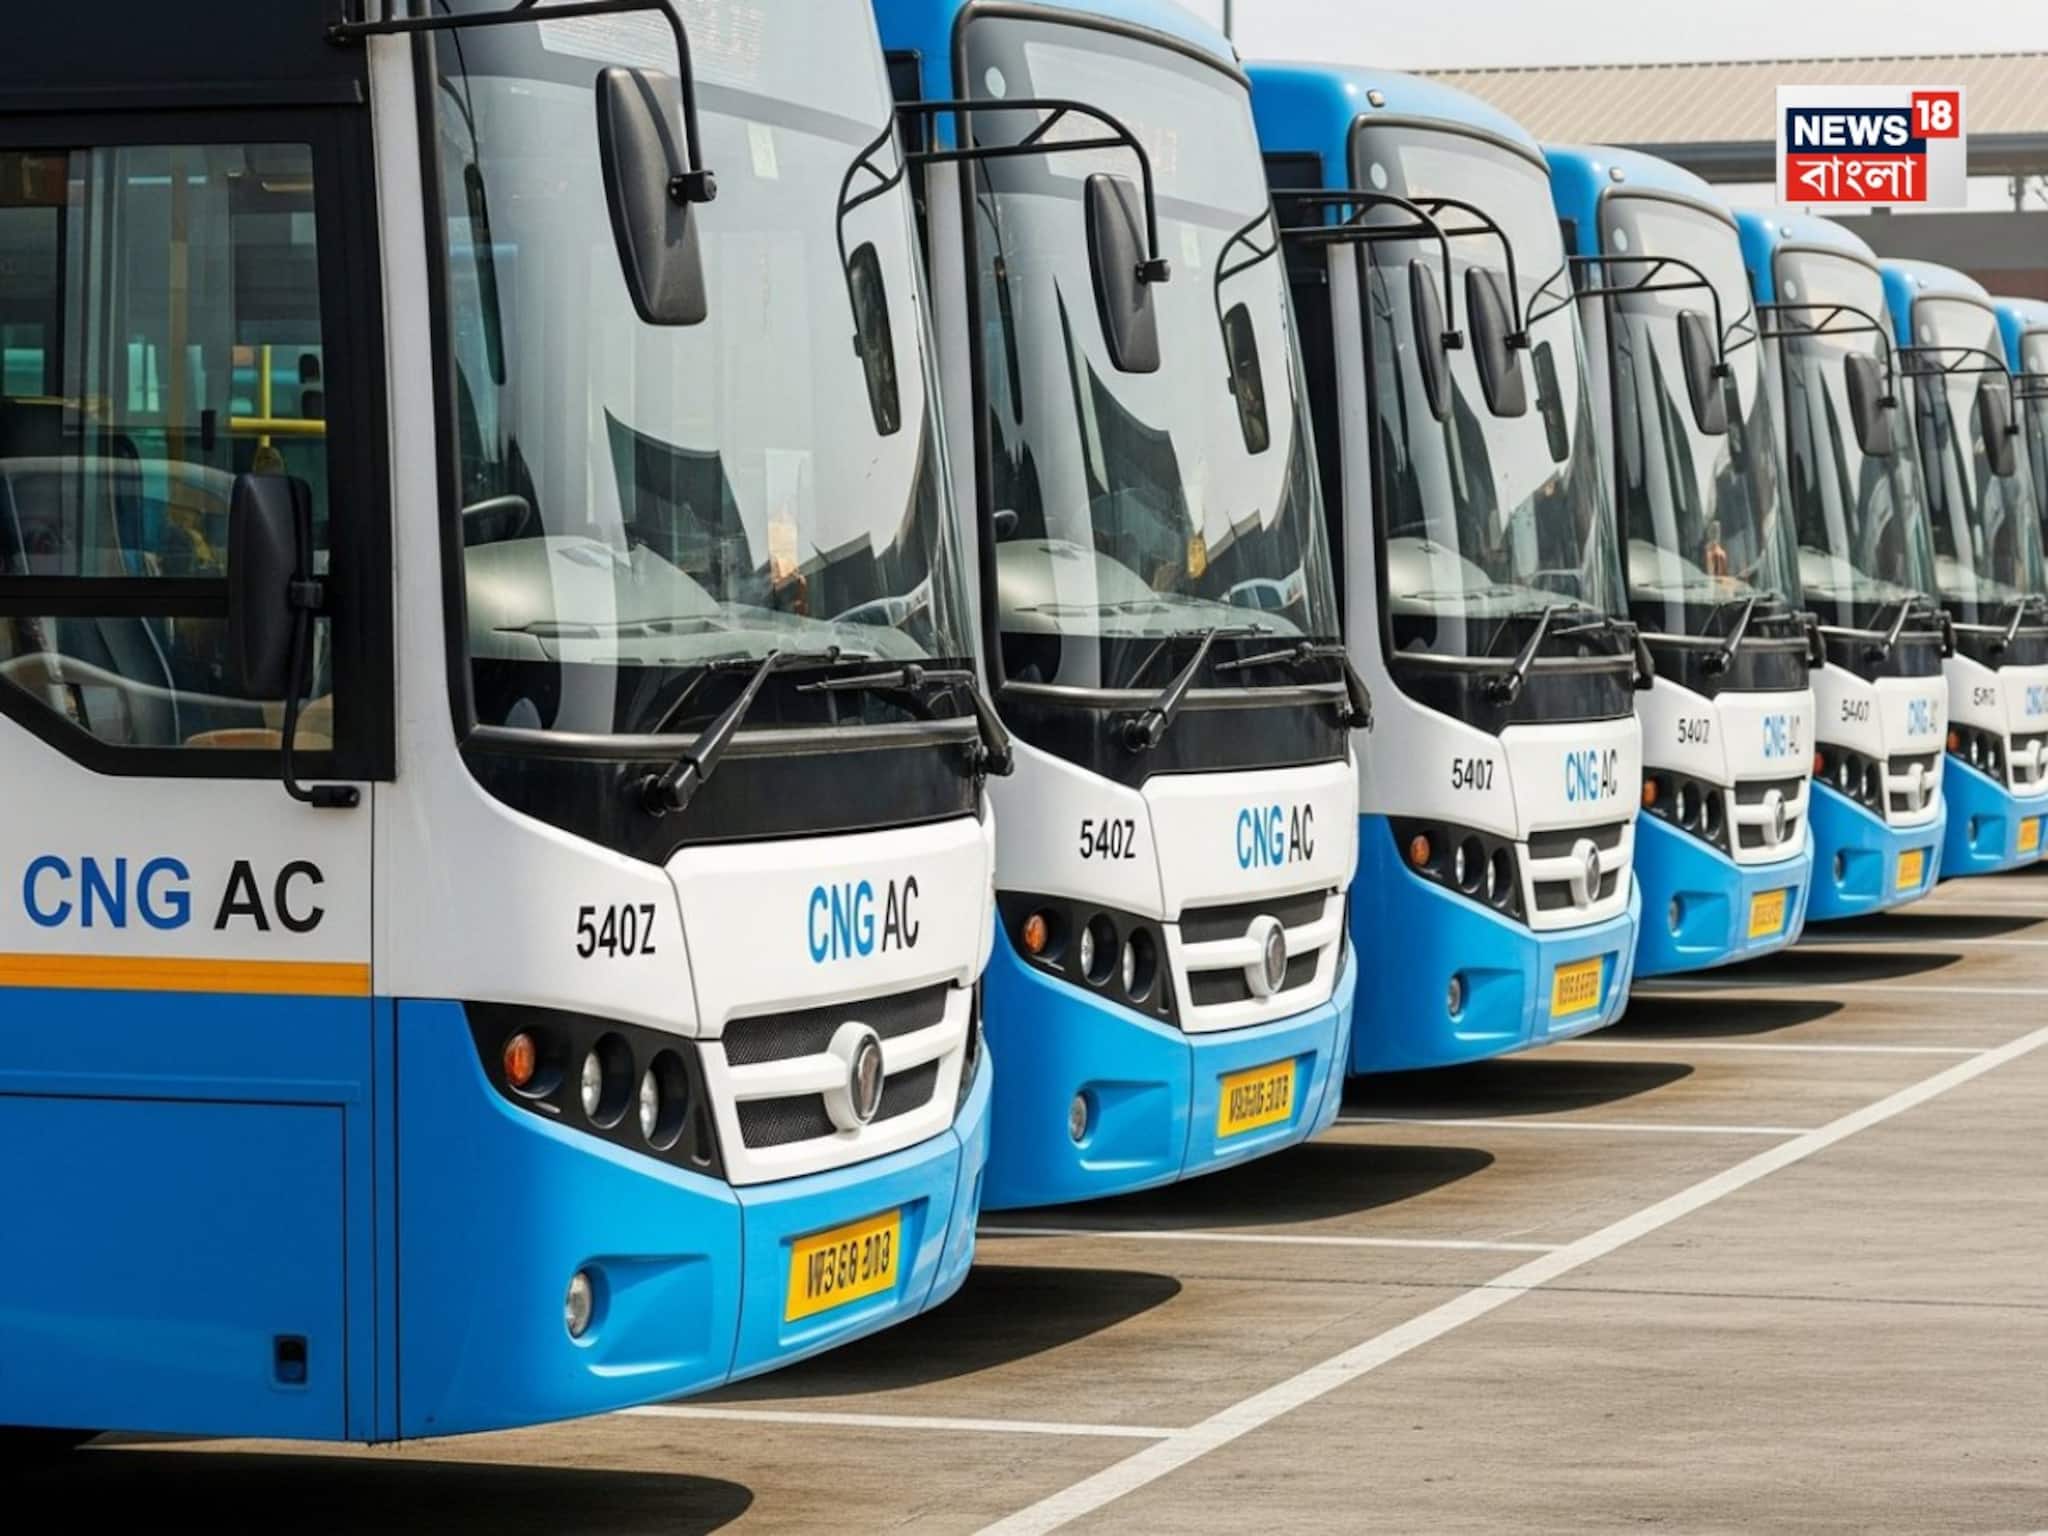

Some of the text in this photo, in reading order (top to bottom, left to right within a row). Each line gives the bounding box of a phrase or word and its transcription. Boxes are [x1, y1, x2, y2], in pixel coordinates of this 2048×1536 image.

[1452, 758, 1493, 790] 5407
[1566, 749, 1617, 801] CNG AC
[1237, 803, 1314, 869] CNG AC
[23, 855, 325, 933] CNG AC
[808, 875, 919, 963] CNG AC
